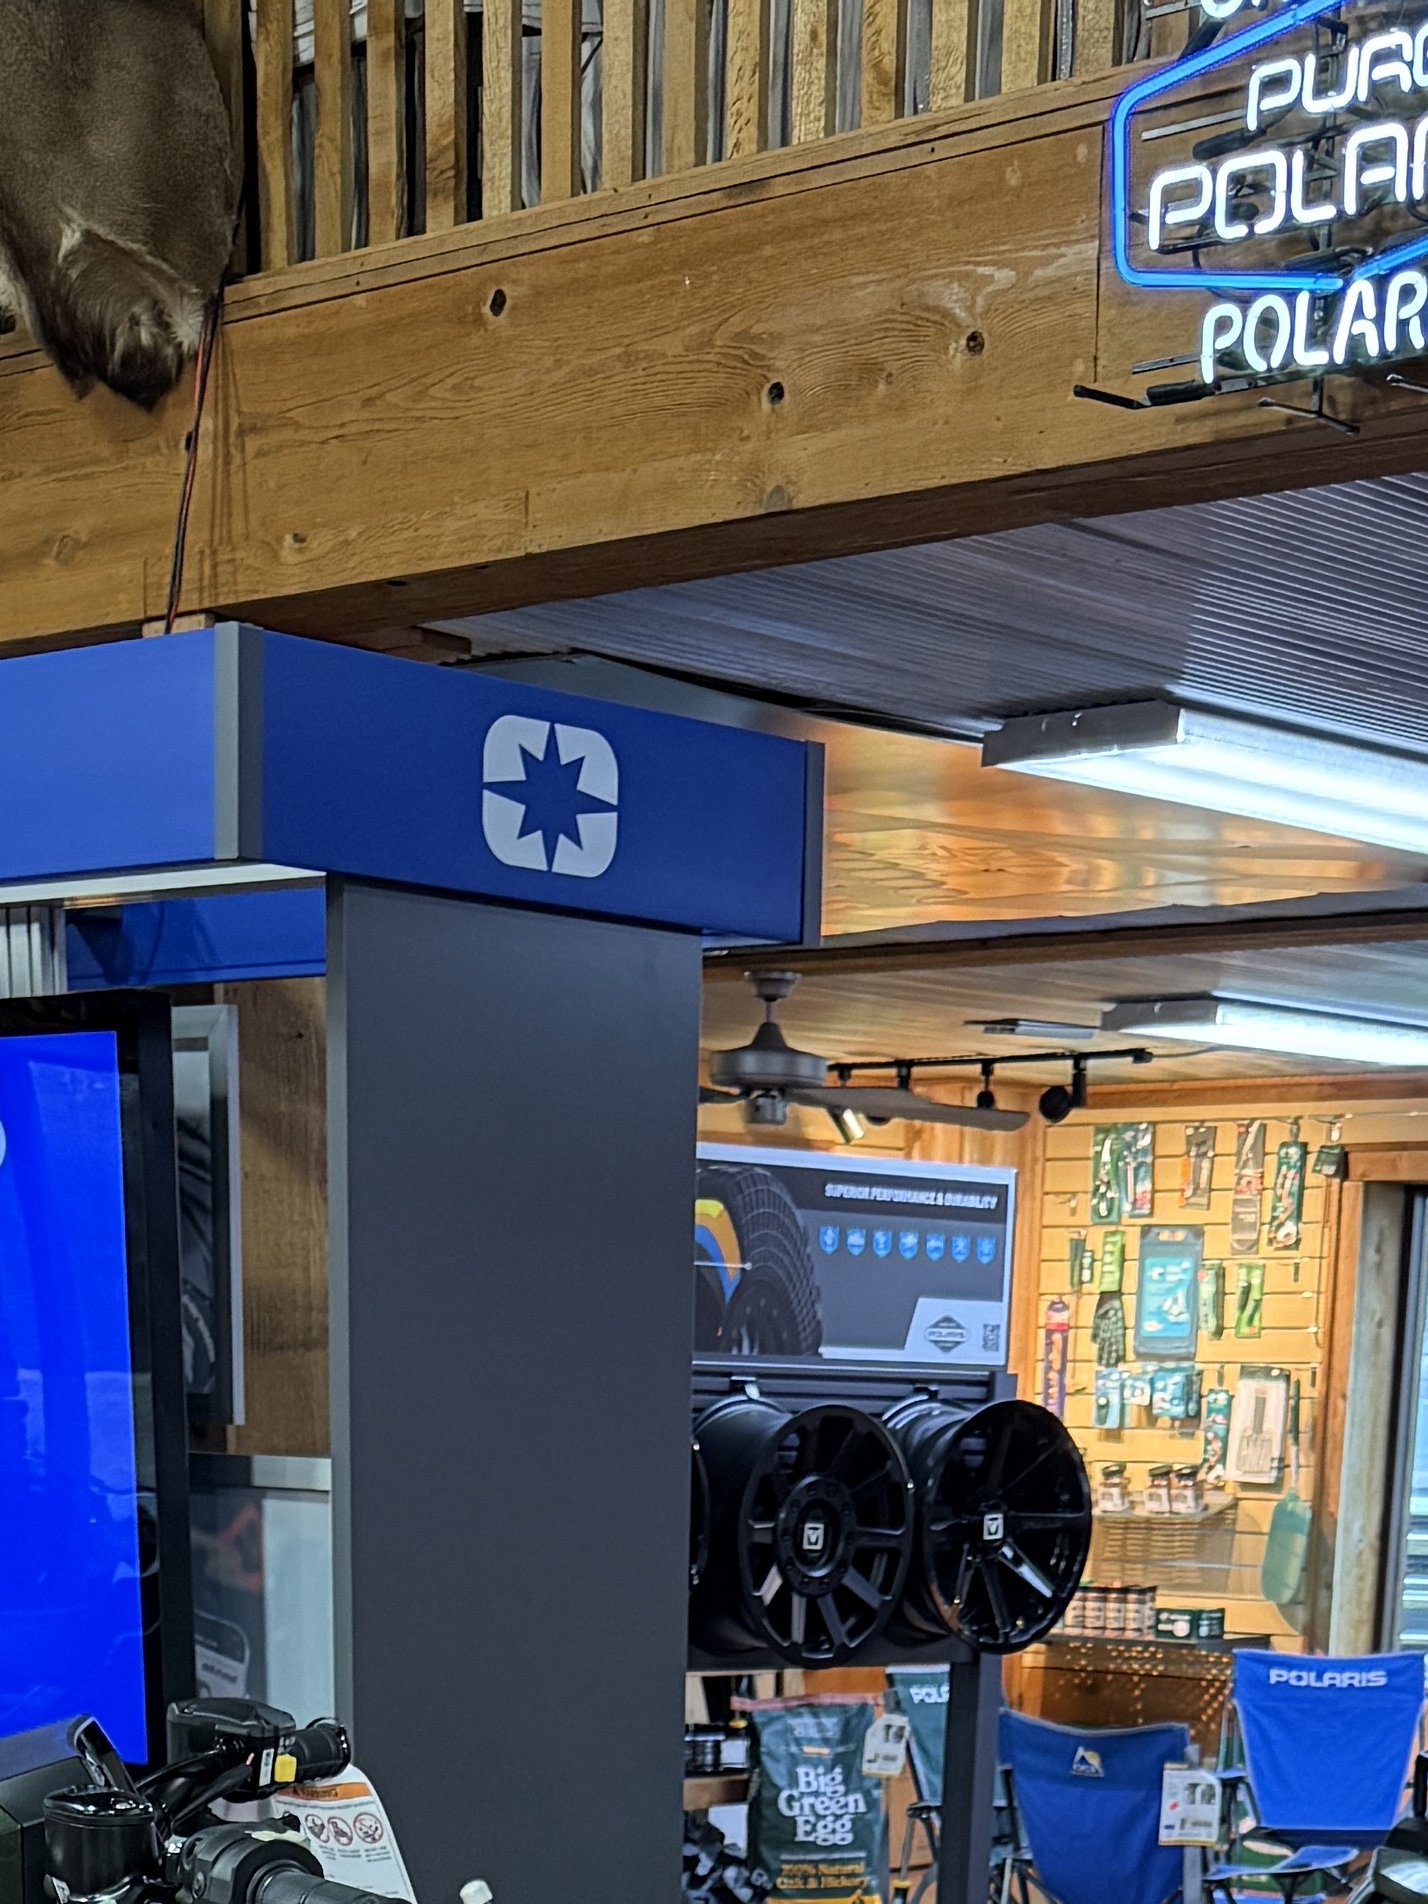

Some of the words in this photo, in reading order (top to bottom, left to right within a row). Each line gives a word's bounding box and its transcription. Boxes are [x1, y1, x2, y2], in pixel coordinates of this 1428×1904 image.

[1269, 1666, 1387, 1690] POLARIS
[795, 1765, 846, 1798] Big
[777, 1789, 868, 1818] Green
[794, 1814, 855, 1846] Egg
